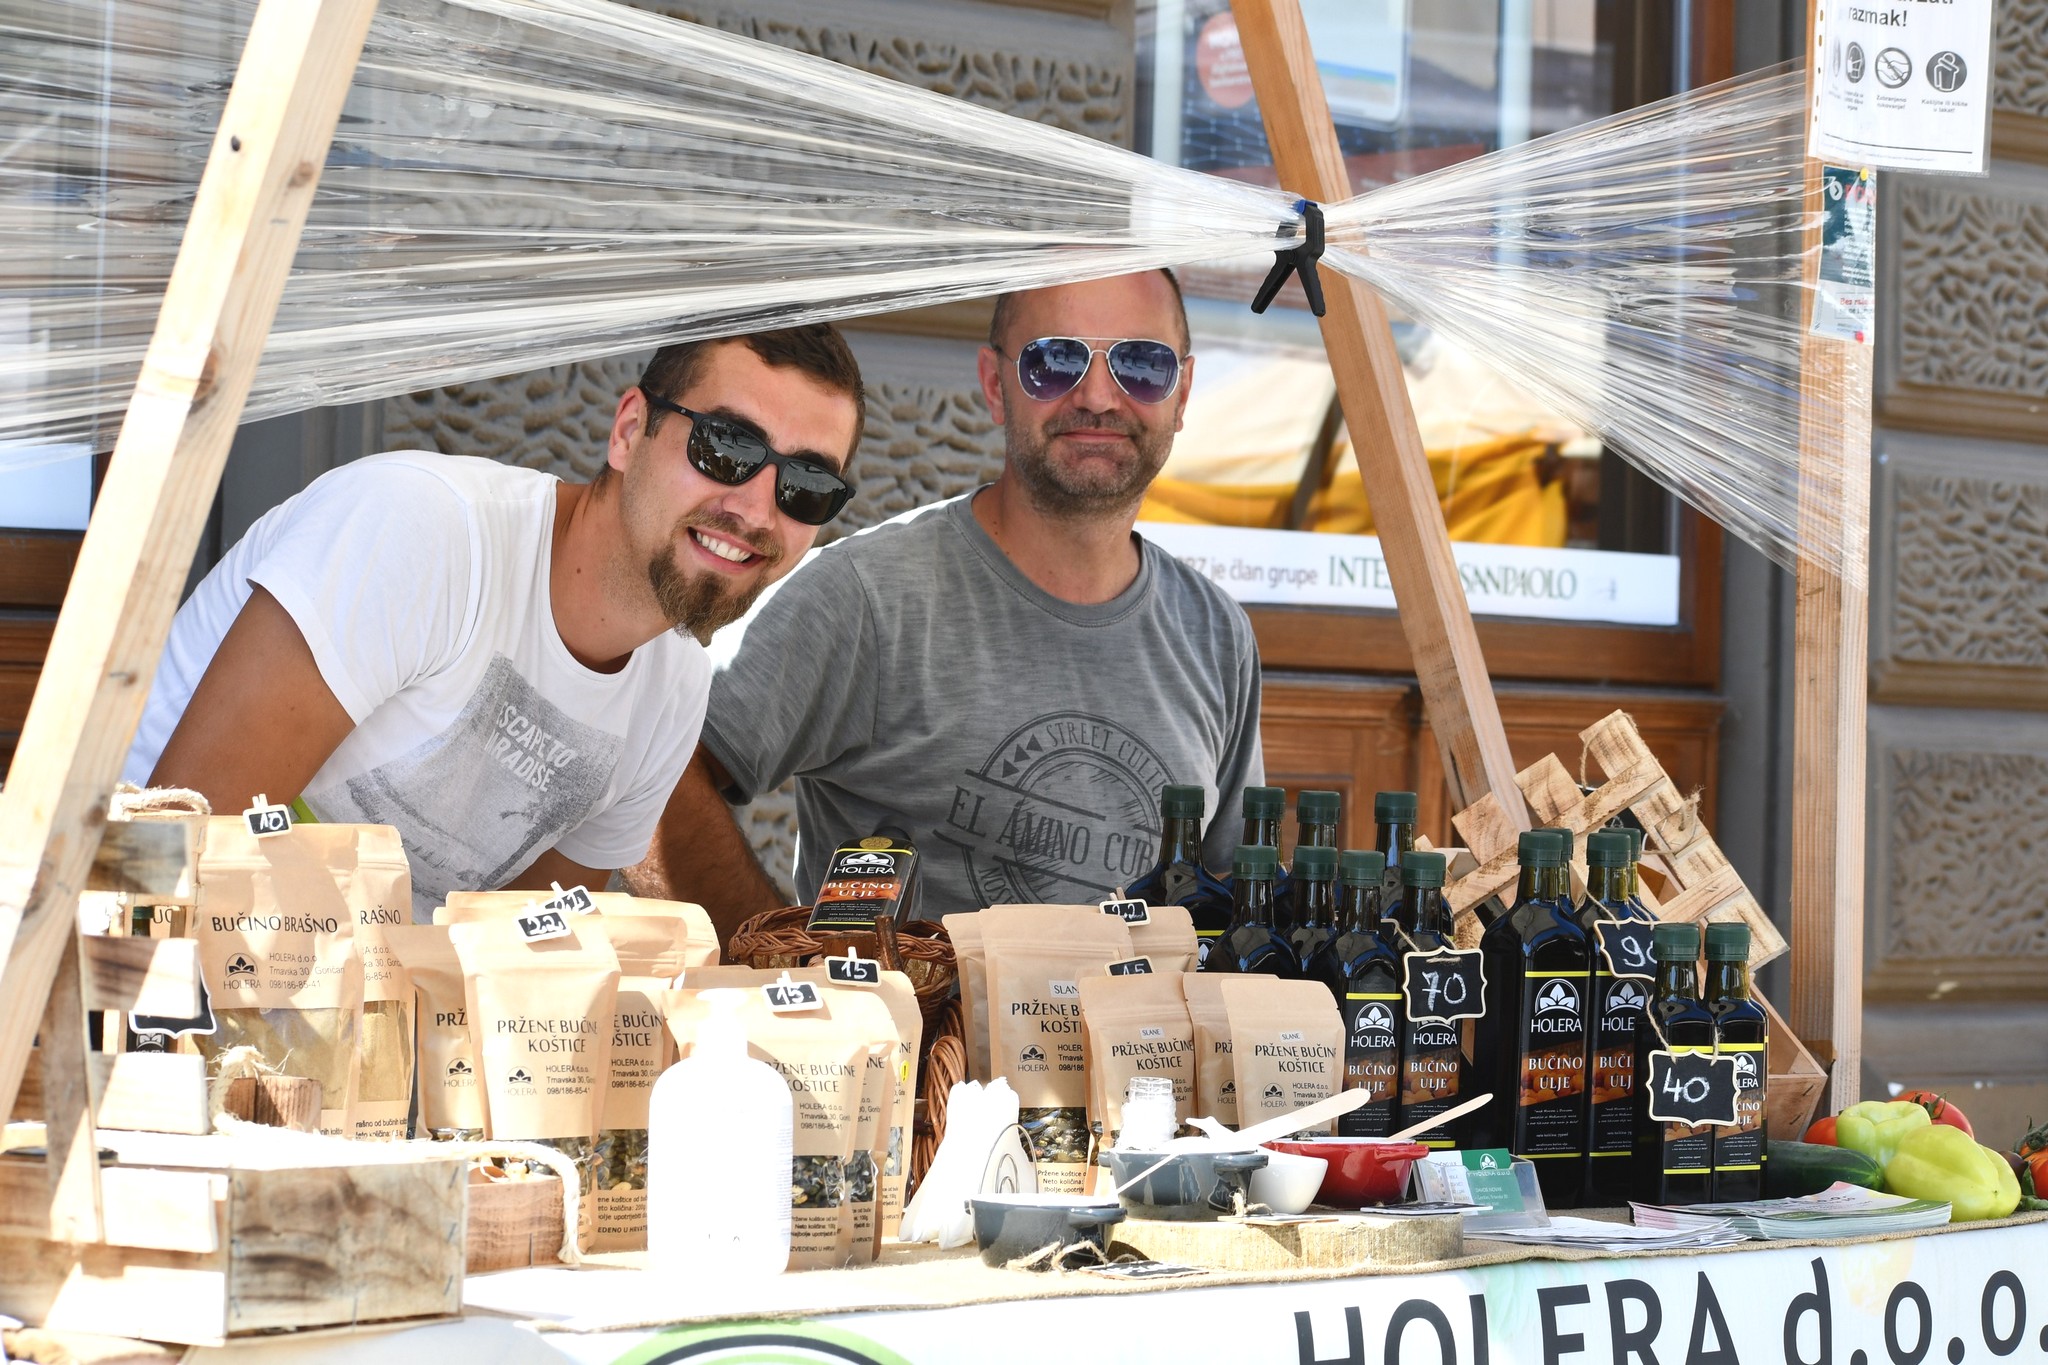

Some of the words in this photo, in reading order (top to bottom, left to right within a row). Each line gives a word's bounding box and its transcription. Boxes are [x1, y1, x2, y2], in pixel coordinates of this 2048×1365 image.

[1848, 7, 1908, 27] razmak!
[1210, 556, 1226, 582] je
[1268, 564, 1319, 589] grupe
[1329, 554, 1393, 589] INTE
[1046, 721, 1113, 752] STREET
[1118, 740, 1168, 798] CULTU
[946, 785, 986, 838] EL
[833, 866, 896, 874] HOLERA
[360, 904, 401, 925] RAŠNO
[212, 911, 281, 933] BUČINO
[284, 912, 338, 934] BRAŠNO
[269, 953, 296, 962] HOLERA
[841, 960, 868, 980] 15
[223, 979, 262, 990] HOLERA
[1054, 984, 1079, 994] SLAN
[1421, 970, 1467, 1012] 70
[777, 985, 805, 1005] 15
[1011, 999, 1068, 1016] PRŽENE
[436, 1008, 468, 1027] PRŽ
[497, 1016, 556, 1033] PRŽENE
[622, 1010, 663, 1028] BUČIN
[1041, 1017, 1082, 1033] KOŠTI
[1601, 1016, 1635, 1033] HOLE
[1141, 1028, 1160, 1036] SLANE
[1530, 1018, 1583, 1033] HOLERA
[528, 1035, 586, 1053] KOŠTICE
[611, 1029, 652, 1047] ŠTICE
[1350, 1035, 1396, 1048] HOLERA
[1413, 1032, 1457, 1046] HOLERA
[1057, 1044, 1083, 1052] HOLER
[1111, 1041, 1157, 1057] PRŽENE
[1157, 1037, 1195, 1053] BUČINE
[1215, 1040, 1232, 1054] PRŽ
[1255, 1043, 1298, 1057] PRŽENE
[611, 1059, 639, 1067] HOLERA
[1058, 1054, 1084, 1062] Trnavsk
[1136, 1054, 1183, 1070] KOŠTICE
[1279, 1058, 1326, 1073] KOŠTICE
[1410, 1057, 1458, 1073] BUČINO
[1528, 1051, 1584, 1071] BUČINO
[1599, 1050, 1633, 1069] BUČI
[546, 1065, 575, 1073] HOLERA
[765, 1059, 807, 1075] ŽENE
[810, 1061, 856, 1078] BUČINE
[1017, 1064, 1049, 1072] HOLERA
[1349, 1059, 1396, 1076] BUČINO
[1357, 1081, 1386, 1092] ULJE
[1420, 1077, 1447, 1090] ULJE
[1539, 1075, 1570, 1090] ULJE
[1610, 1074, 1632, 1089] ULJ
[1662, 1067, 1710, 1104] 40
[1736, 1078, 1759, 1088] LERA
[799, 1103, 827, 1111] HOLERA
[1217, 1096, 1236, 1104] HOLE
[1736, 1100, 1760, 1111] ČINO
[1737, 1115, 1753, 1126] LJE
